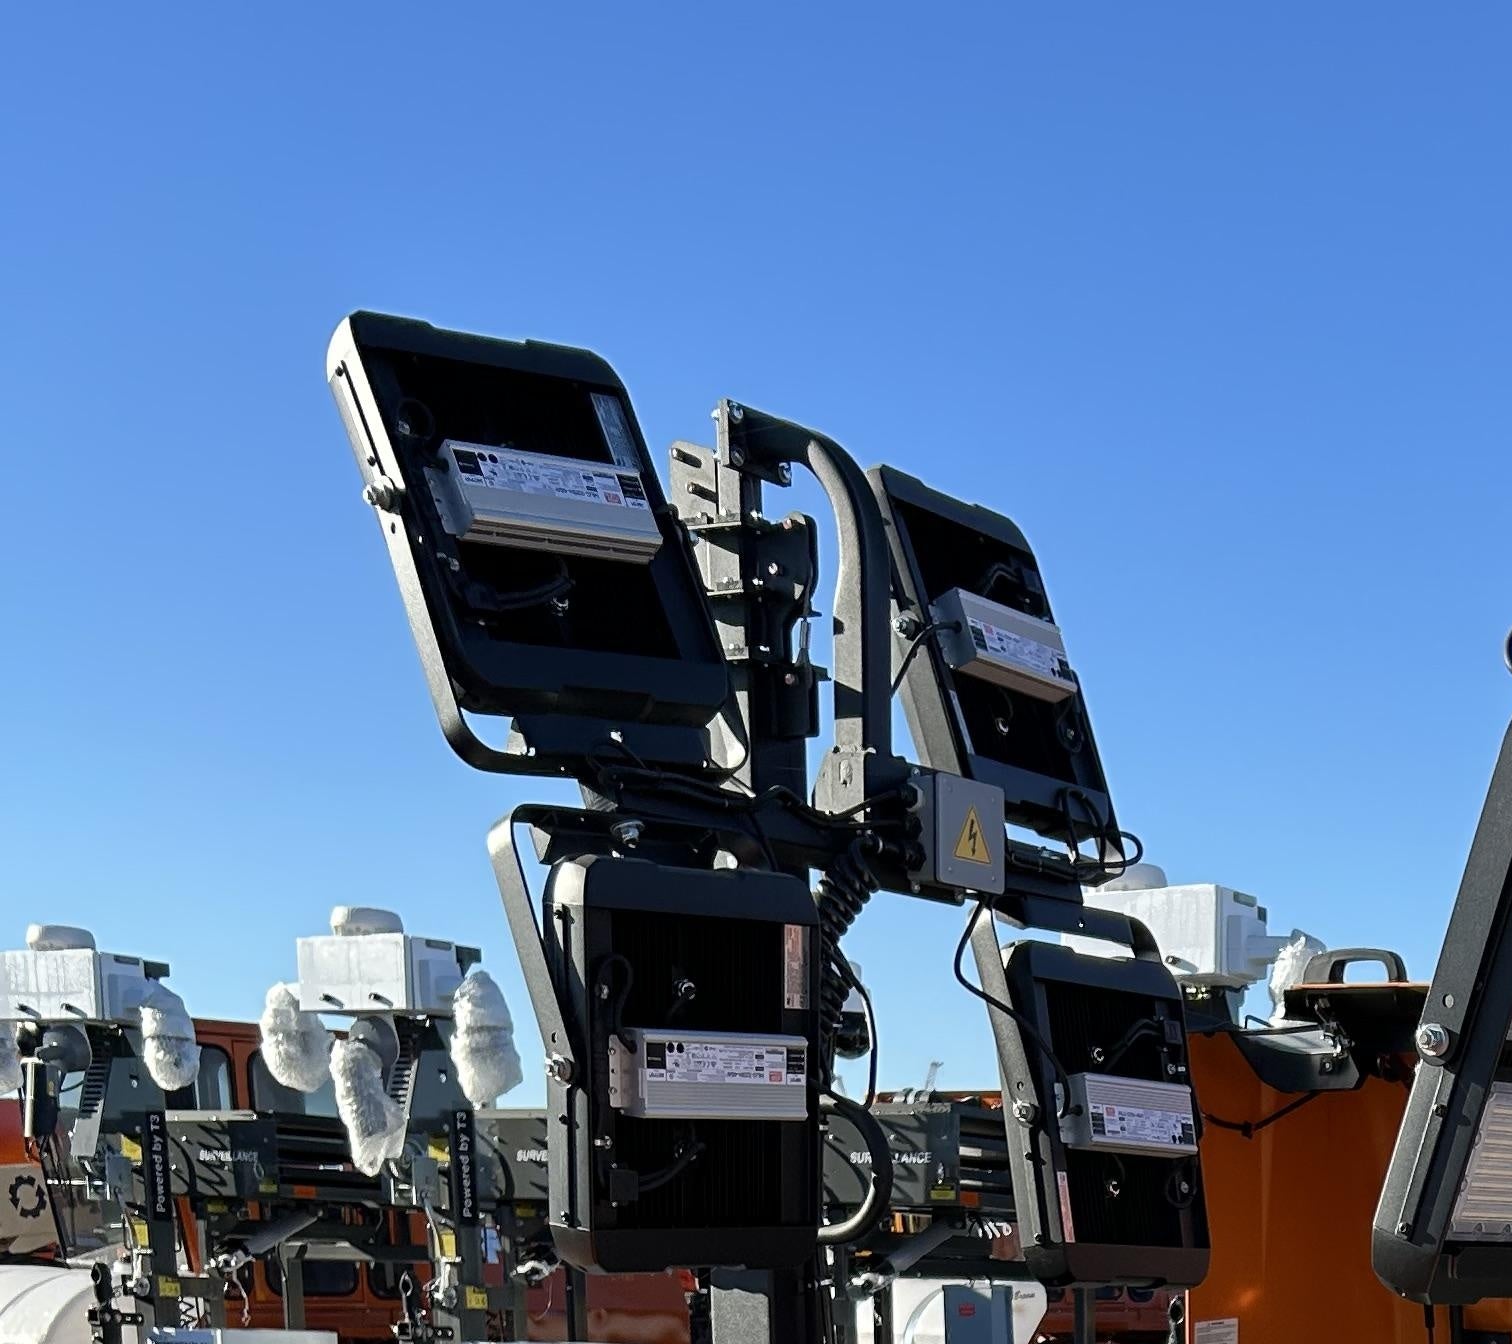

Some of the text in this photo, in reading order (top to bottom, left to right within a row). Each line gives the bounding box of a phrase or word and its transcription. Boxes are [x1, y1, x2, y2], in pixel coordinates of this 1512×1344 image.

[149, 1113, 166, 1213] Powered by T3
[456, 1111, 473, 1218] Powered by T3
